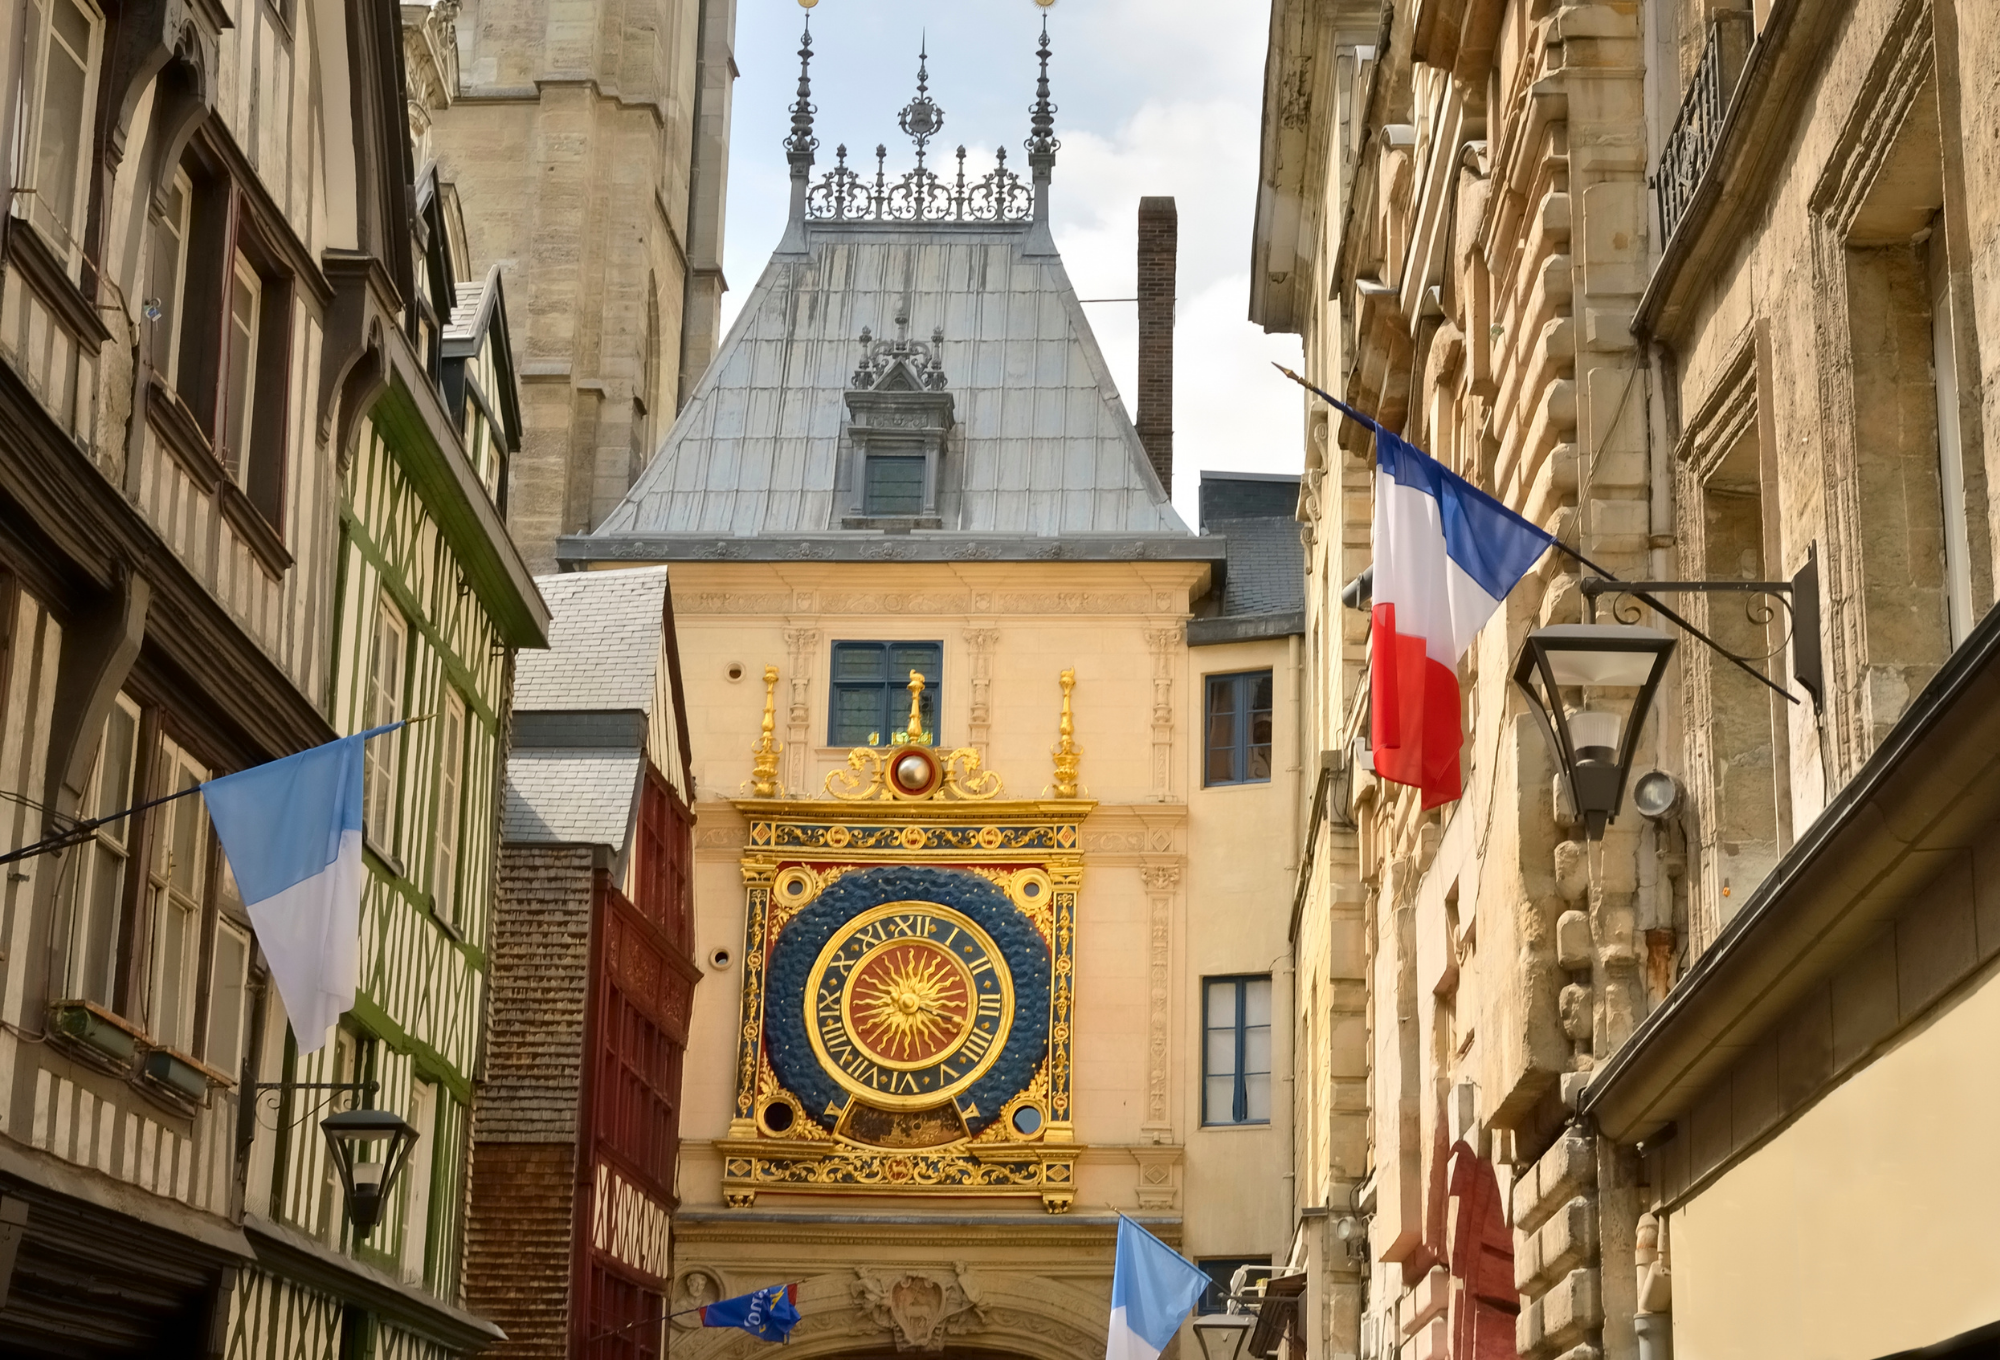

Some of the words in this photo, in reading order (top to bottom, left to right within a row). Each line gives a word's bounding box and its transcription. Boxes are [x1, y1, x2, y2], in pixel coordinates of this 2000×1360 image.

[854, 922, 887, 953] XI
[893, 916, 931, 938] XII
[945, 927, 961, 946] I
[829, 950, 857, 976] X
[969, 956, 993, 977] II
[818, 988, 841, 1018] IX
[979, 993, 1001, 1017] III
[820, 1022, 852, 1066] VIII
[960, 1027, 992, 1063] IIII
[845, 1057, 878, 1089] VII
[889, 1071, 920, 1094] VI
[939, 1063, 960, 1087] V
